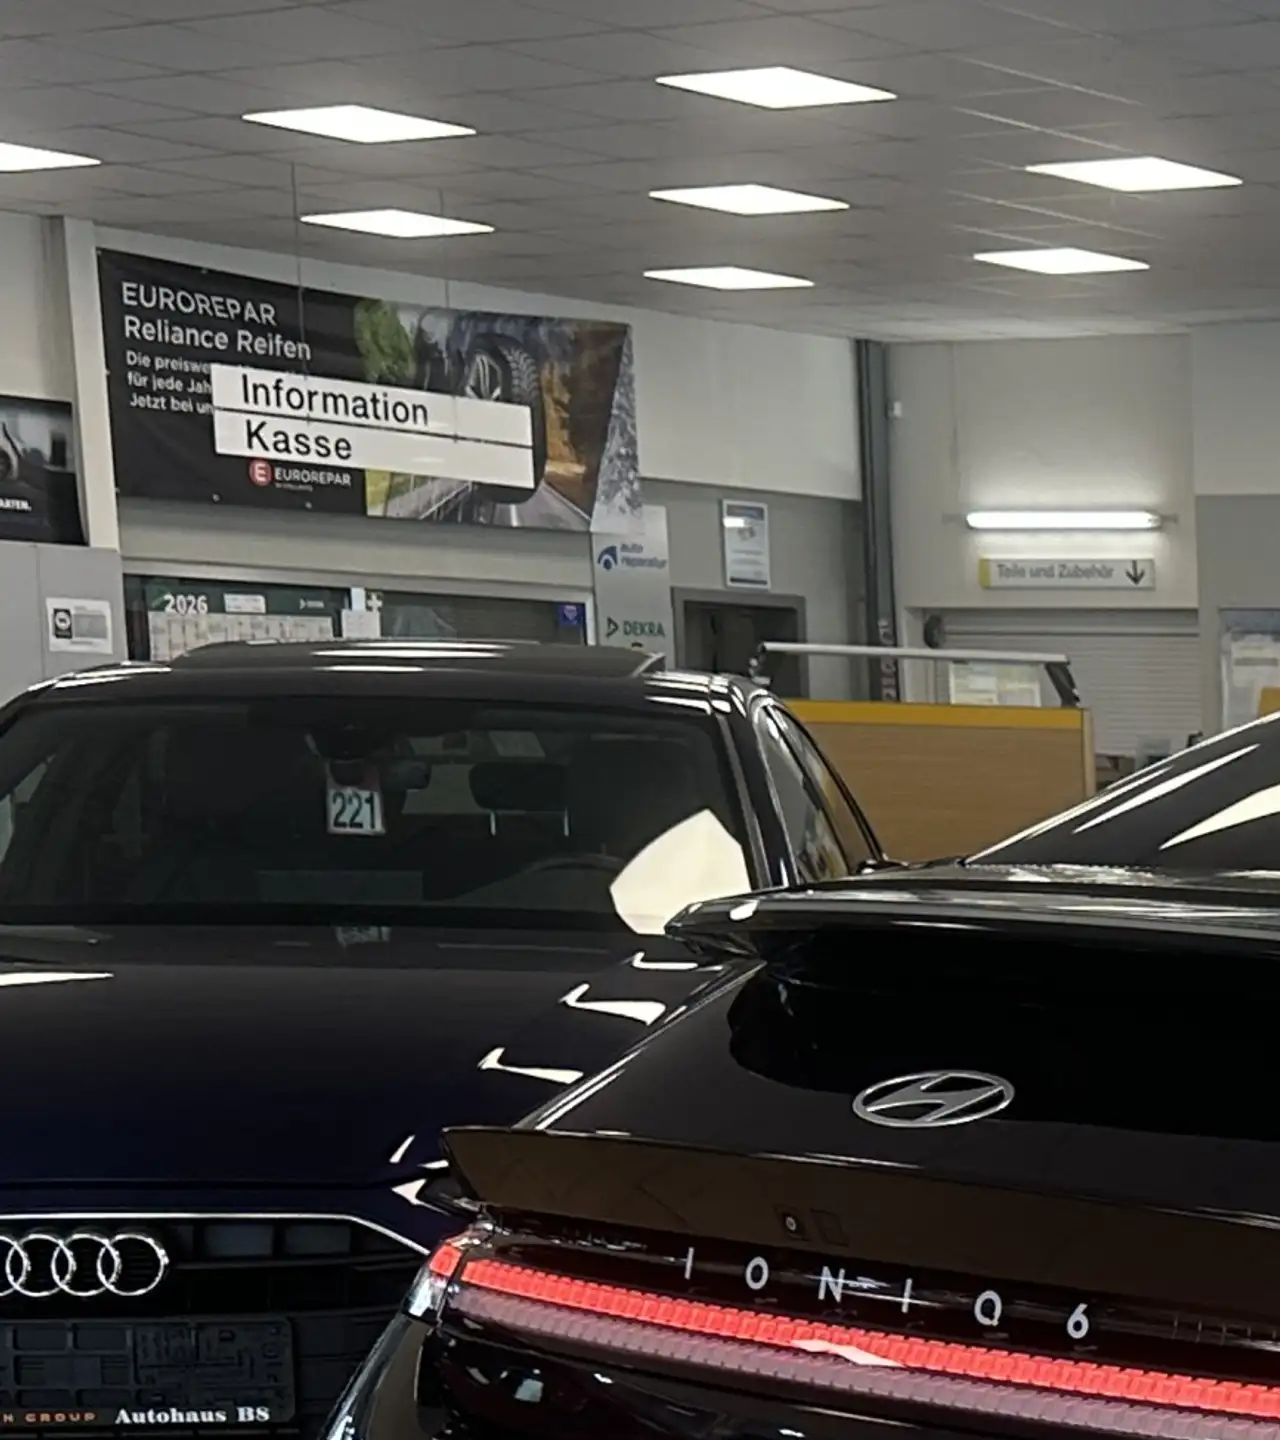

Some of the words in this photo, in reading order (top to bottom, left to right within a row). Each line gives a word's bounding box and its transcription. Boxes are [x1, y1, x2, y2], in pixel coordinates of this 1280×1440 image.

[121, 281, 277, 326] EUROREPAR
[123, 315, 229, 350] Reliance
[237, 329, 312, 360] Reifen
[126, 350, 151, 367] Die
[127, 371, 148, 388] für
[152, 374, 183, 392] jede
[130, 394, 167, 411] Jetzt
[170, 395, 194, 412] bei
[242, 373, 429, 426] Information
[246, 419, 353, 460] Kasse
[274, 466, 352, 486] EUROREPAR
[1029, 563, 1055, 579] und
[164, 592, 208, 616] 2026
[623, 619, 665, 637] DEKRA
[332, 790, 375, 829] 221
[684, 1246, 1003, 1327] IONIQ
[1066, 1302, 1090, 1340] 6
[24, 1411, 97, 1424] GROUP
[115, 1406, 227, 1425] Autohaus
